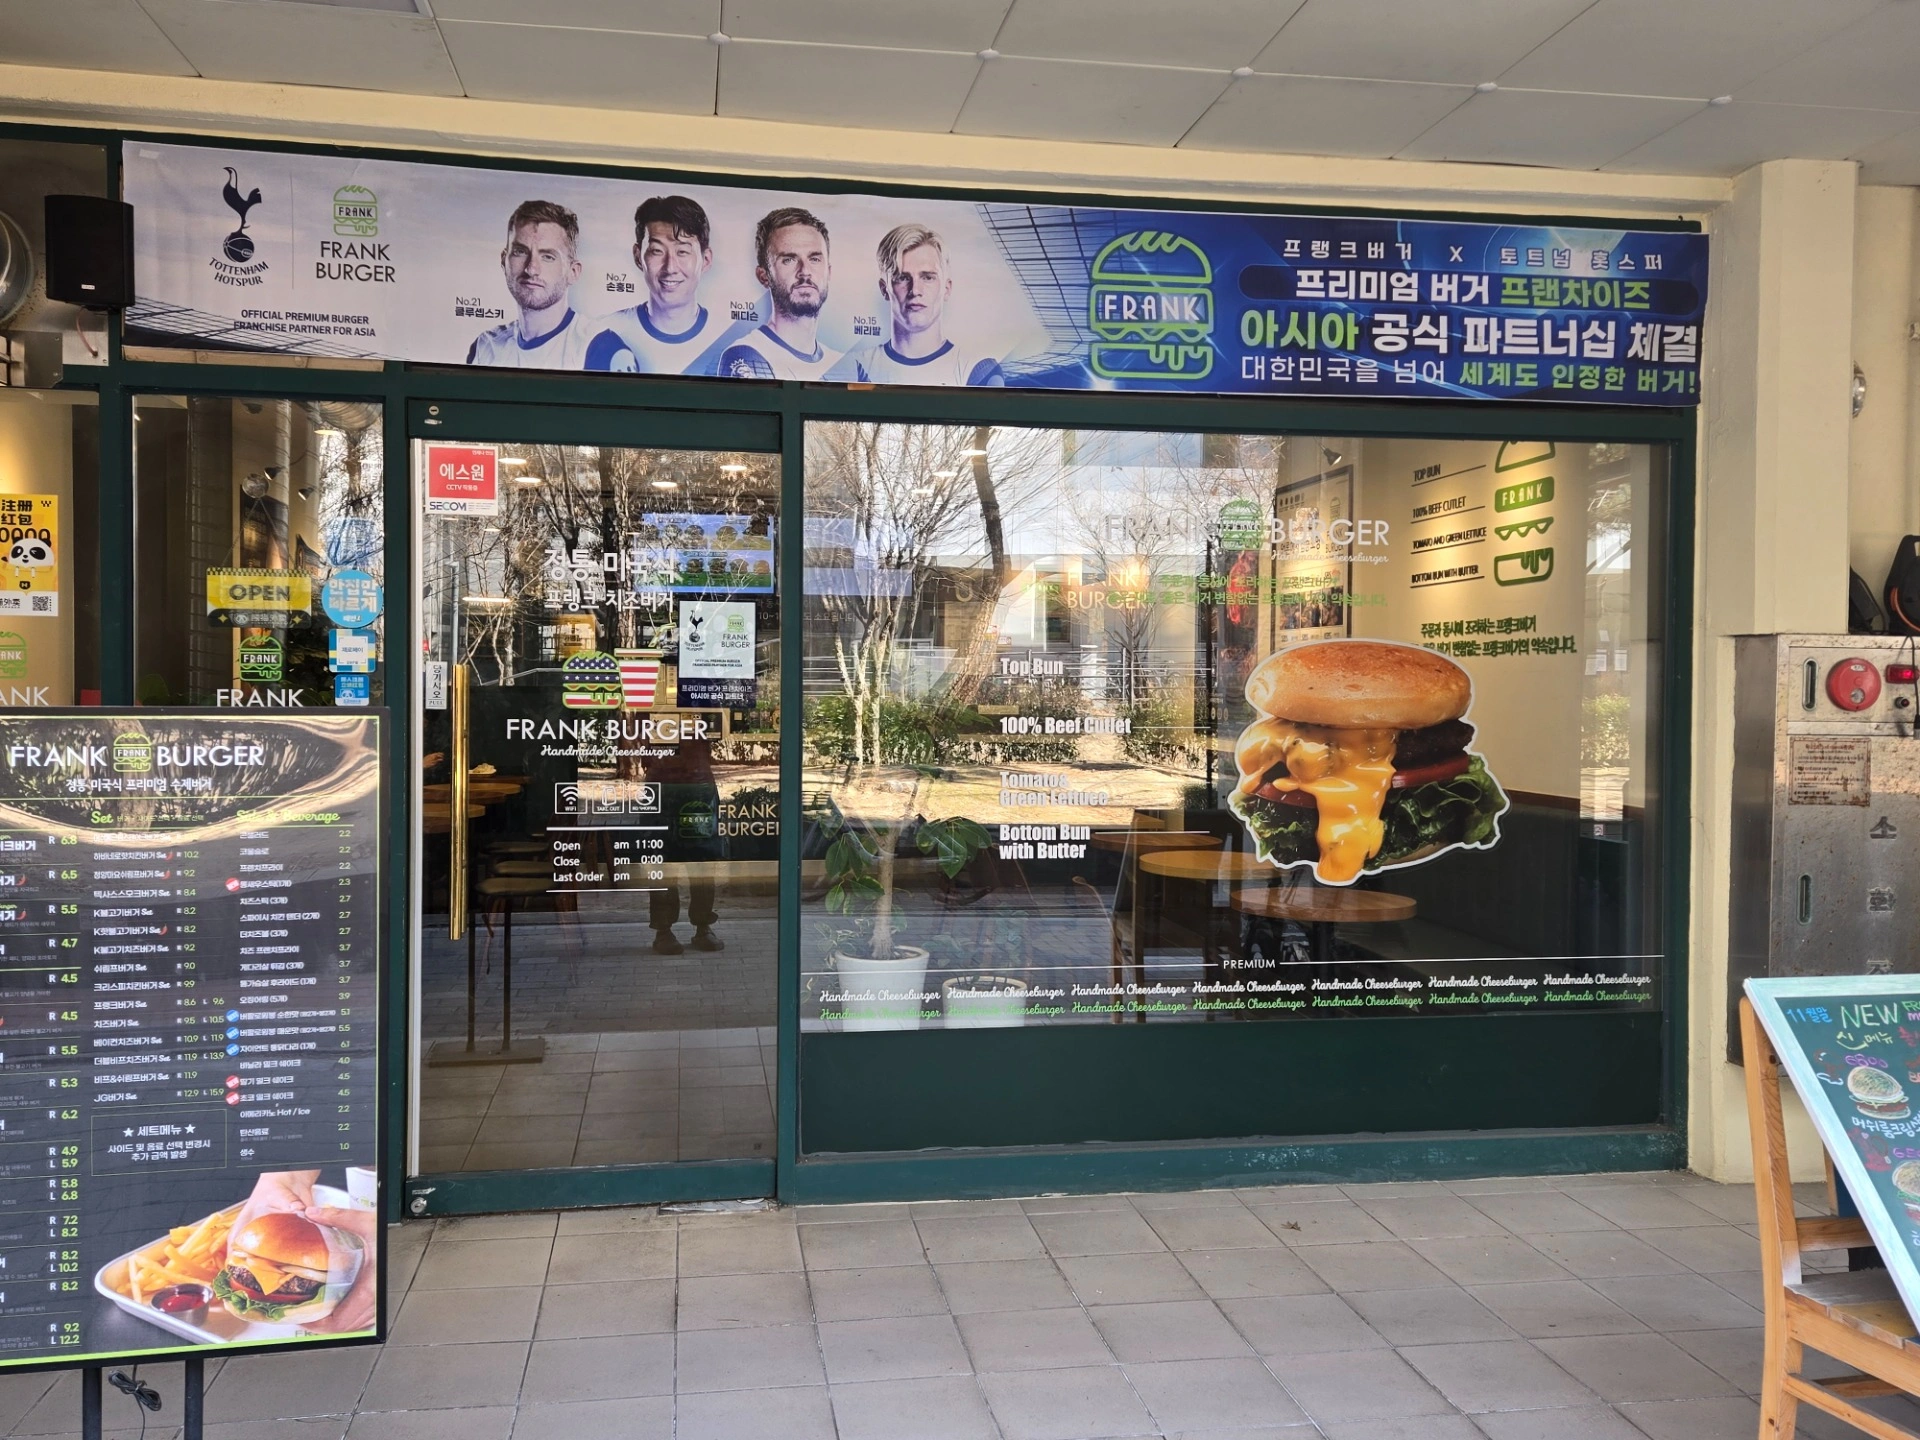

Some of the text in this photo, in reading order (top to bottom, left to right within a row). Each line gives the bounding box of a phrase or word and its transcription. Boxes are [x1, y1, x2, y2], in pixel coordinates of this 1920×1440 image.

[338, 205, 373, 217] FRANK
[320, 240, 390, 261] FRANK
[1283, 239, 1413, 262] 프랭크버거
[1500, 247, 1571, 268] 토트넘
[1591, 250, 1664, 273] 홋스퍼
[208, 256, 270, 277] TOTTENHAM
[316, 262, 395, 283] BURGER
[214, 272, 264, 287] HOTSPUR
[606, 273, 627, 283] No.7
[606, 282, 635, 293] 손흥민
[1295, 270, 1651, 309] 프리미엄 버거 프랜차이즈
[455, 296, 482, 307] No.21
[729, 301, 756, 311] No.10
[1103, 293, 1200, 322] FRANK
[241, 309, 369, 325] OFFICIAL PREMIUM BURGER
[454, 307, 504, 319] 클루셉스키
[730, 311, 759, 322] 메디슨
[853, 315, 877, 326] No.15
[233, 321, 376, 337] FRANCHISE PARTNER FOR ASIA
[1241, 309, 1697, 364] 아시아 공식 파트너십 체결
[1241, 355, 1697, 394] 대한민국을 넘어 세계도 인정한 버거!
[439, 463, 484, 481] 에스원
[1413, 464, 1441, 481] TOP BUN
[1501, 482, 1543, 507] FRANK
[429, 501, 467, 511] SECOM
[1412, 495, 1466, 519] 100% BEEF CUTLET
[1271, 519, 1390, 546] BURGER
[1433, 535, 1445, 546] AND
[1445, 531, 1462, 544] GREEN
[1462, 526, 1487, 540] LETTUCE
[544, 548, 675, 584] 정통 미국식
[1411, 571, 1432, 584] BOTTOM
[1432, 570, 1444, 581] BUN
[1458, 564, 1479, 577] BUTTER
[229, 584, 291, 602] OPEN
[544, 588, 600, 612] 프랭크
[722, 633, 749, 641] FRANK
[1420, 622, 1442, 639] 주문과
[243, 654, 277, 664] FRANK
[1000, 657, 1064, 675] Top Bun
[432, 664, 442, 699] 당기시오
[216, 688, 304, 707] FRANK
[506, 718, 708, 741] FRANK BURGER
[999, 716, 1132, 734] 100% Beef Cutlet
[10, 744, 264, 767] FRANK FRANK BURGER
[541, 744, 675, 759] Handmade Cheeseburger
[66, 777, 212, 792] 정통 미국식 프리미엄 수제버거
[999, 790, 1109, 807] Green Lettuce
[91, 810, 114, 824] Set
[718, 804, 777, 819] FRANK
[999, 824, 1091, 841] Bottom Bun
[61, 836, 78, 845] 6.8
[553, 839, 664, 853] Open am 11:00
[184, 851, 199, 859] 10.2
[999, 842, 1087, 860] with Butter
[553, 856, 580, 867] Close
[613, 857, 630, 867] pm
[61, 870, 78, 880] 6.5
[553, 872, 574, 882] Last
[575, 871, 604, 882] Order
[613, 873, 630, 882] pm
[93, 907, 196, 918] K불고기버거 Set 8.2
[61, 938, 78, 948] 4.7
[1222, 959, 1275, 969] PREMIUM
[947, 974, 1538, 1001] Handmade Cheeseburger Handmade Cheeseburger Handmade Cheeseburger
[93, 998, 196, 1010] 프랭크버거 8.6
[1841, 1002, 1898, 1029] NEW
[93, 1034, 199, 1047] 베이컨치즈버거 10.9
[94, 1088, 225, 1103] JG버거 15.9
[137, 1125, 182, 1137] 세트메뉴
[108, 1143, 134, 1153] 사이드
[166, 1141, 183, 1150] 선택
[58, 1262, 79, 1273] 10.2
[59, 1334, 80, 1345] 12.2
